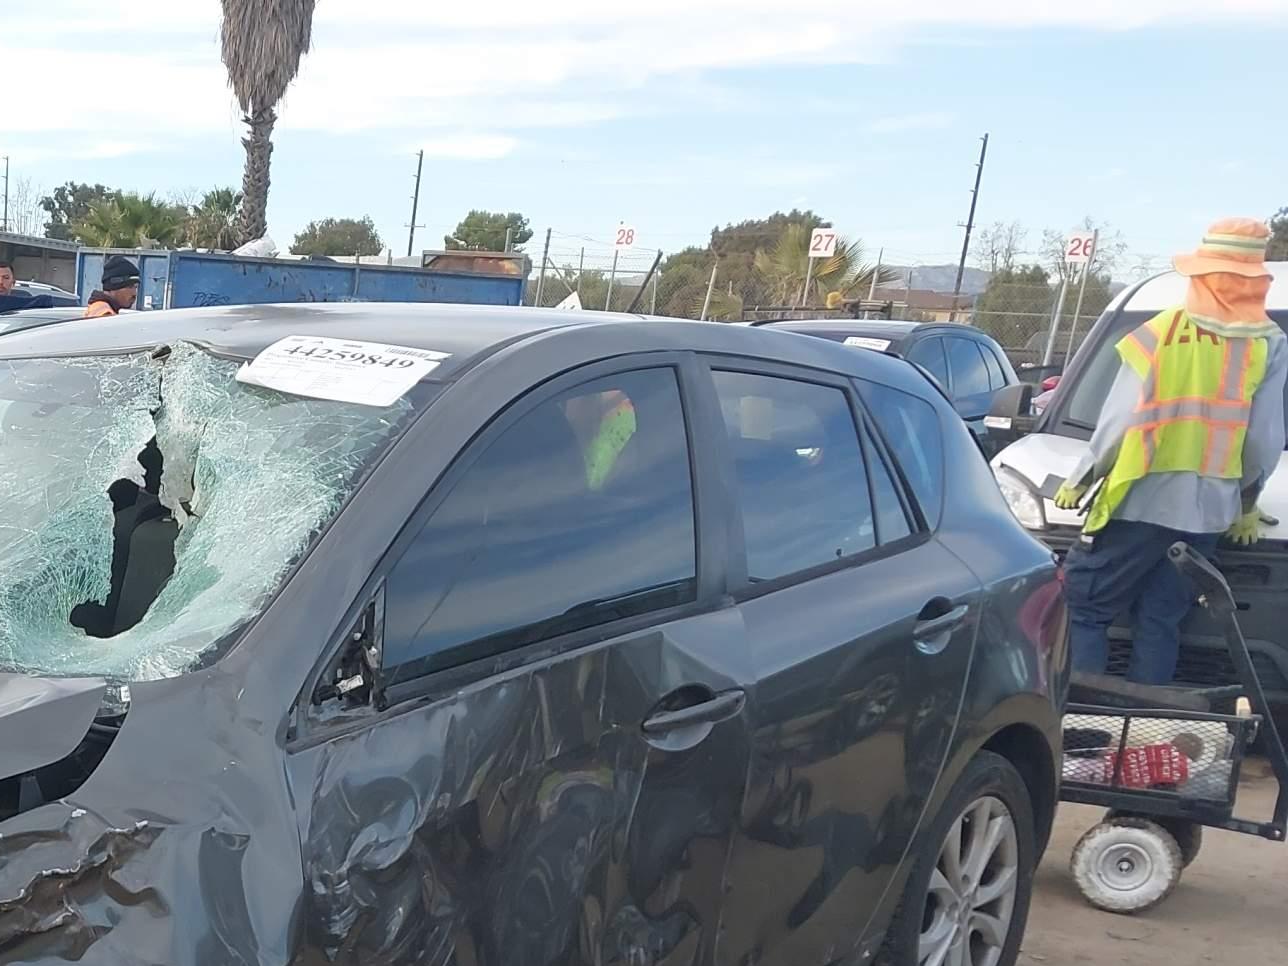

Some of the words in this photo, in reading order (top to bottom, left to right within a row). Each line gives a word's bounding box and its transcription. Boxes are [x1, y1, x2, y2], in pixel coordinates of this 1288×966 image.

[615, 229, 634, 245] 28
[812, 234, 835, 251] 27
[1068, 238, 1094, 256] 26
[283, 345, 415, 369] 44259849
